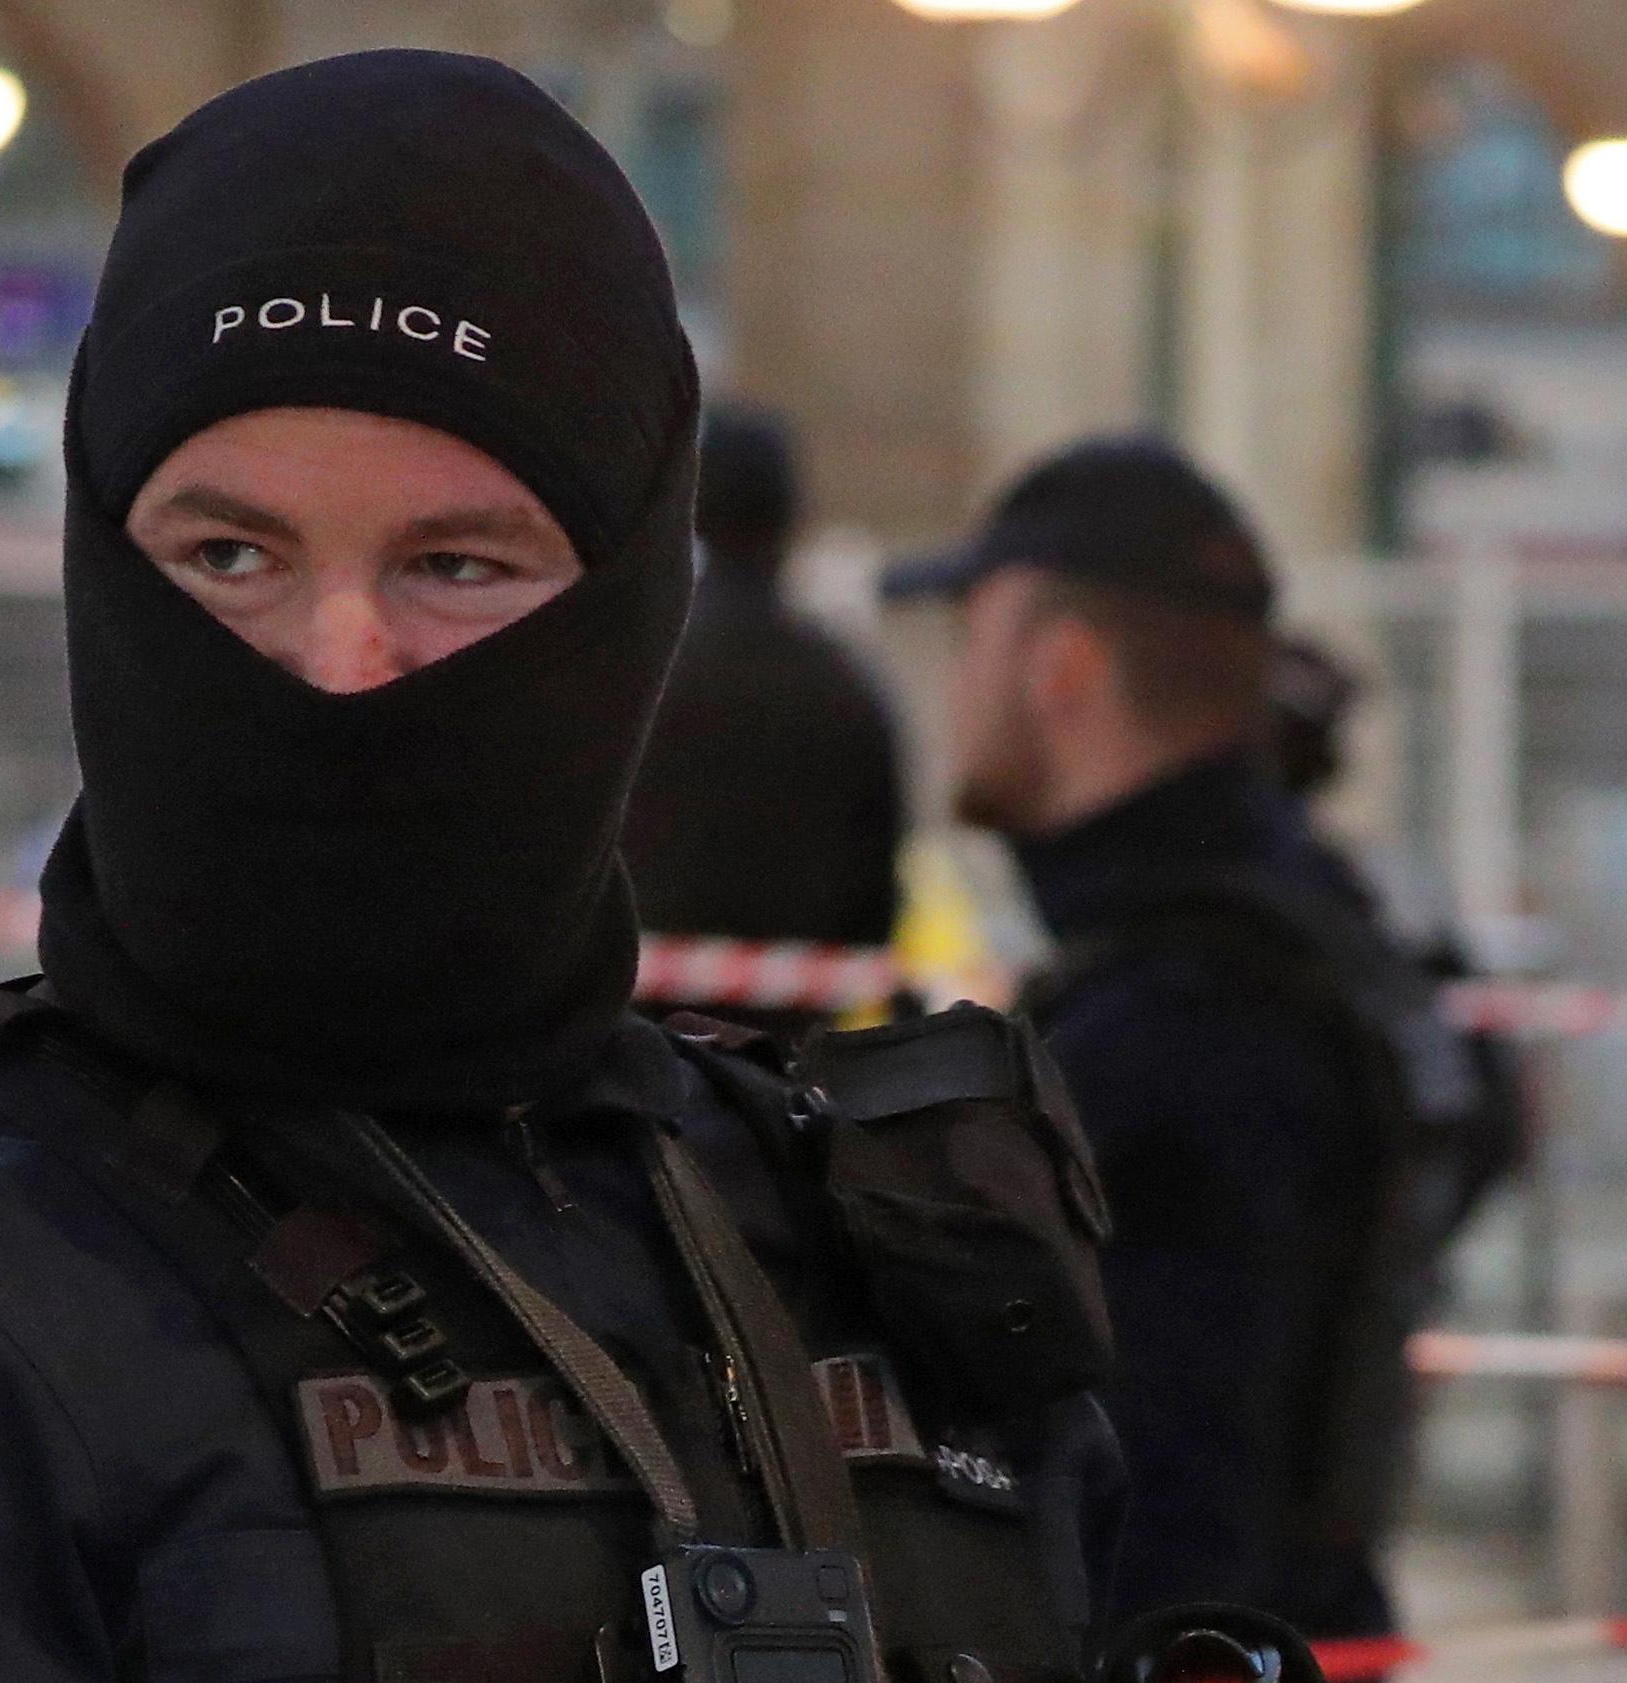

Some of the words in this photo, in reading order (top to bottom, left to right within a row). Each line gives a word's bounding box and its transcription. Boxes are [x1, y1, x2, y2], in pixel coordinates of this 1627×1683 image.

[211, 292, 492, 362] POLICE
[318, 1383, 613, 1481] POLIC
[648, 1573, 669, 1640] 704707
